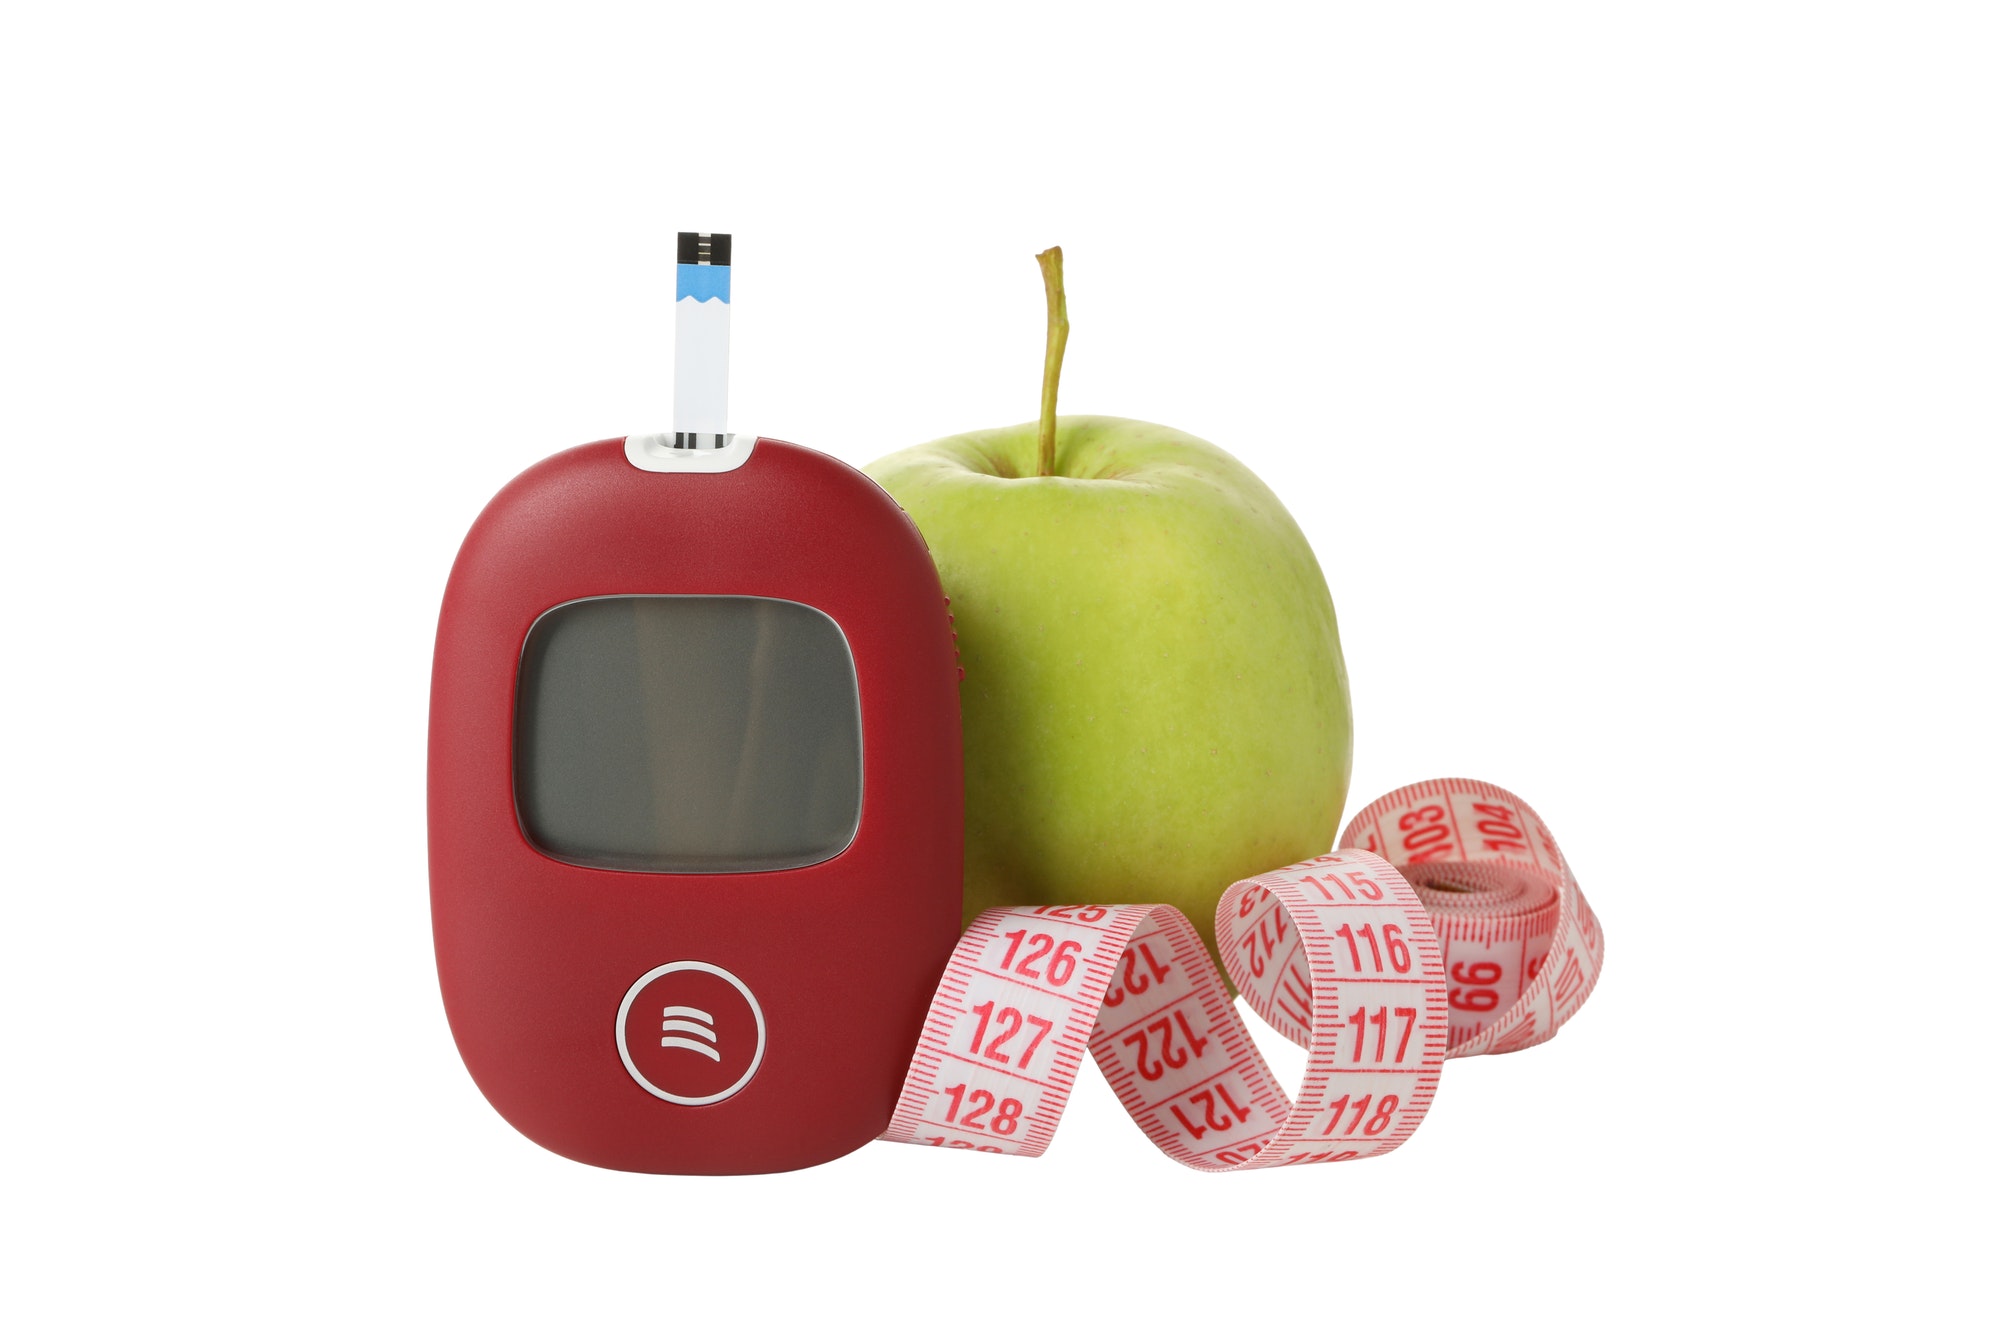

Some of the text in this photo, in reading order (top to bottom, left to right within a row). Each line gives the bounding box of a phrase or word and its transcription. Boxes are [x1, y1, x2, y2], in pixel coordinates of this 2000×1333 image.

[1472, 802, 1527, 853] 104
[1299, 871, 1384, 901] 115
[999, 929, 1083, 987] 126
[1242, 906, 1288, 979] 112
[1335, 923, 1412, 974] 116
[969, 1001, 1054, 1070] 127
[1122, 1010, 1208, 1082] 122
[1348, 1005, 1417, 1064] 117
[944, 1083, 1024, 1136] 128
[1169, 1083, 1252, 1140] 121
[1321, 1093, 1399, 1136] 118
